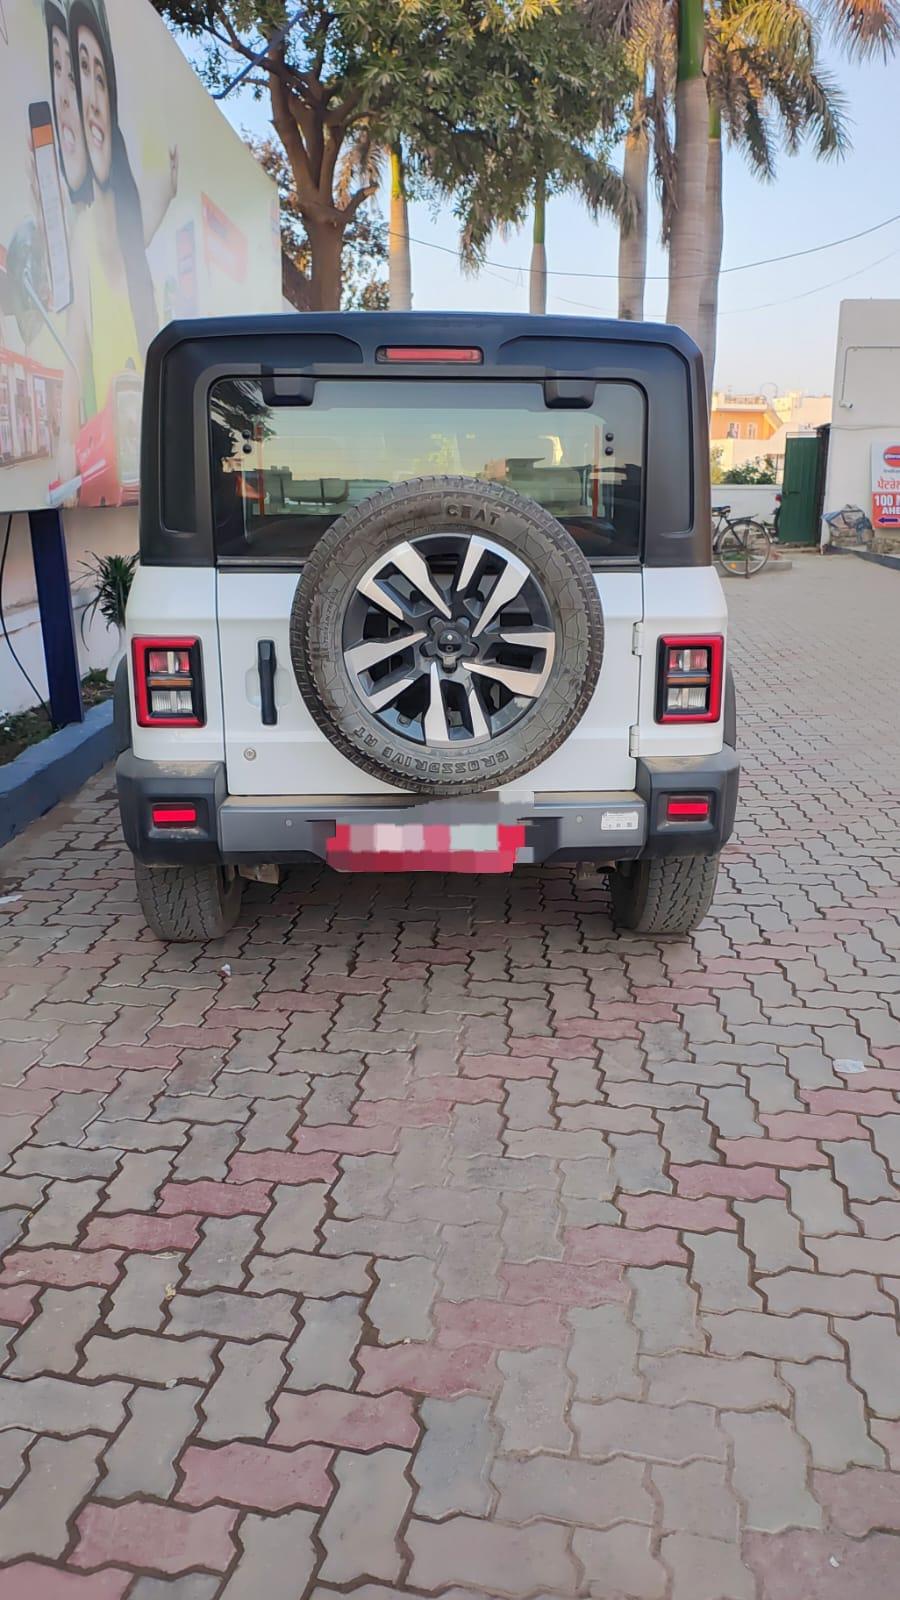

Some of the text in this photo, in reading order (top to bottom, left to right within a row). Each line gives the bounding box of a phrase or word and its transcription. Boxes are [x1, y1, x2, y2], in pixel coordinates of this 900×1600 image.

[875, 494, 894, 507] 100
[447, 503, 501, 526] CEAT
[354, 726, 509, 774] CROSSDRIVE AT
